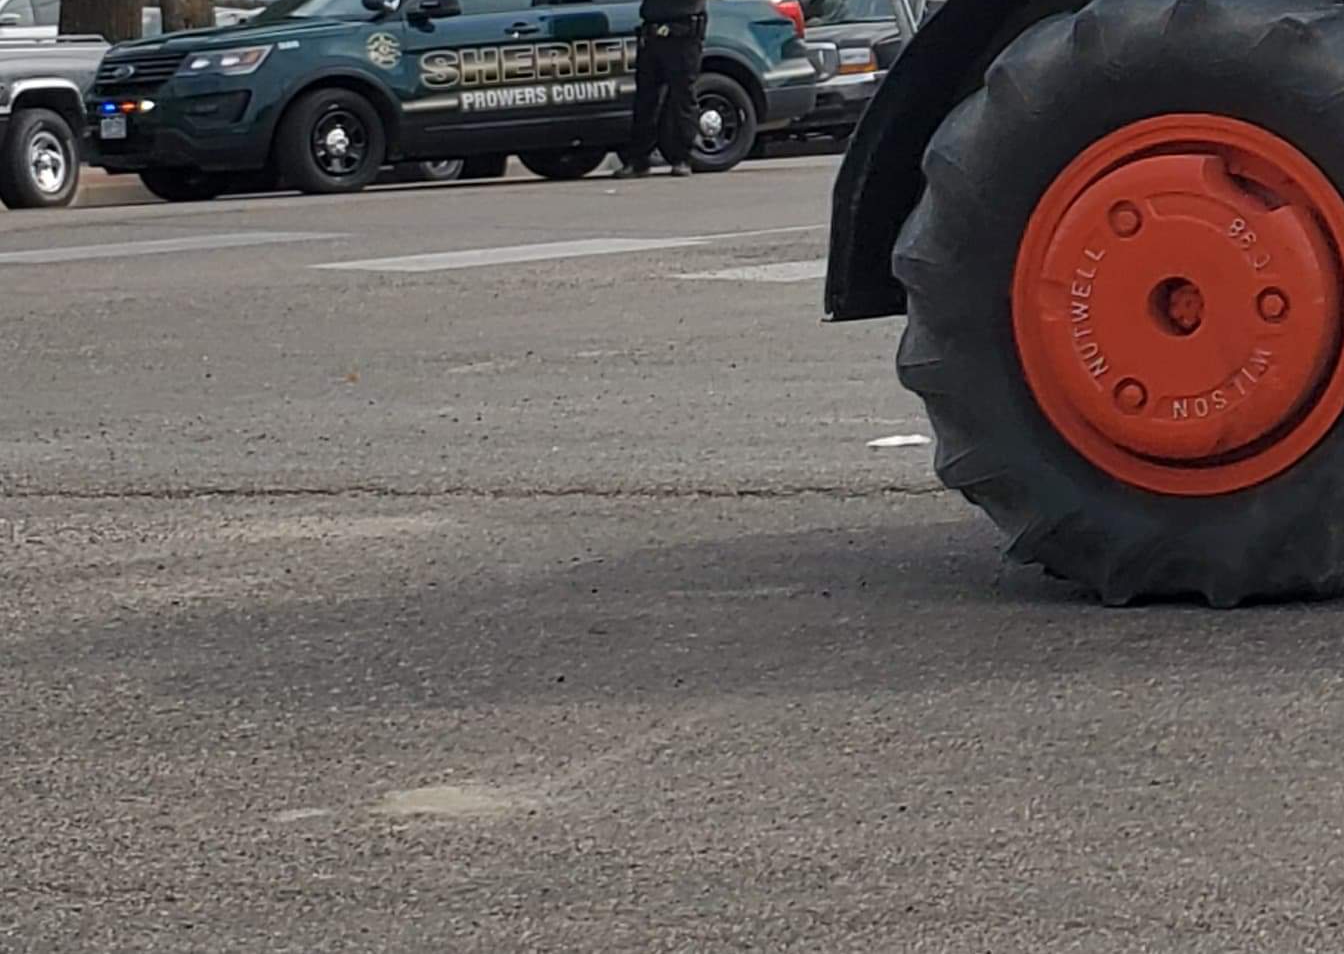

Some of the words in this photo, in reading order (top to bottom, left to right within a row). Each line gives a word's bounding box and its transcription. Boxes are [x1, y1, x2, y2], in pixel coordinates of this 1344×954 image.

[461, 87, 547, 110] PROWERS
[551, 80, 617, 102] COUNTY
[1070, 247, 1110, 380] NUTWELL
[1171, 347, 1274, 421] WILSON
